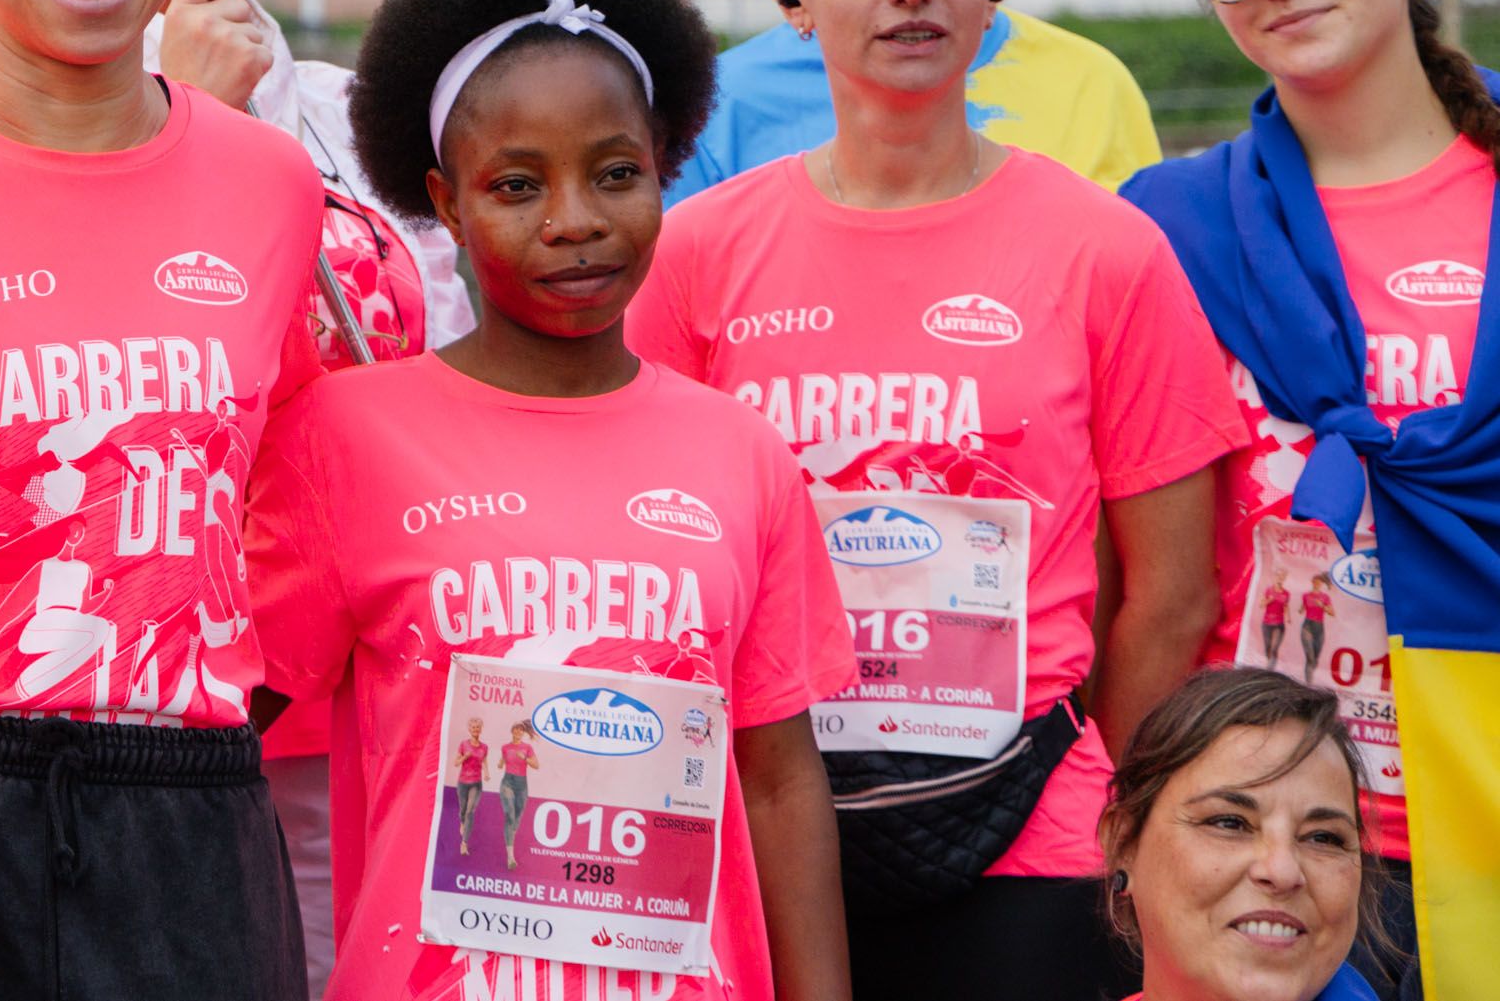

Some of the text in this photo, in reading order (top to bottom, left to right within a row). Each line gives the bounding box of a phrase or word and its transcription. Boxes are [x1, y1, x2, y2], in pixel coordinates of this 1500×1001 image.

[164, 269, 242, 296] ASTURIANA
[726, 305, 834, 345] OYSHO
[930, 311, 1015, 337] ASTURIANA
[115, 444, 204, 557] DE
[403, 491, 527, 534] OYSHO
[637, 502, 717, 537] ASTURIANA
[829, 530, 933, 552] ASTURIANA
[430, 557, 705, 649] CARRERA
[469, 684, 524, 706] SUMA
[484, 674, 525, 689] DORSAL
[860, 683, 908, 699] MUJER
[920, 686, 931, 700] A
[935, 686, 994, 706] CORUÑA
[542, 707, 655, 744] ASTURIANA
[902, 719, 990, 740] Santander
[533, 801, 647, 857] 016
[562, 861, 615, 885] 1298
[455, 873, 690, 917] CARRERA DE LA MUJER A CORUÑA
[459, 908, 554, 941] OYSHO
[615, 931, 684, 955] Santander
